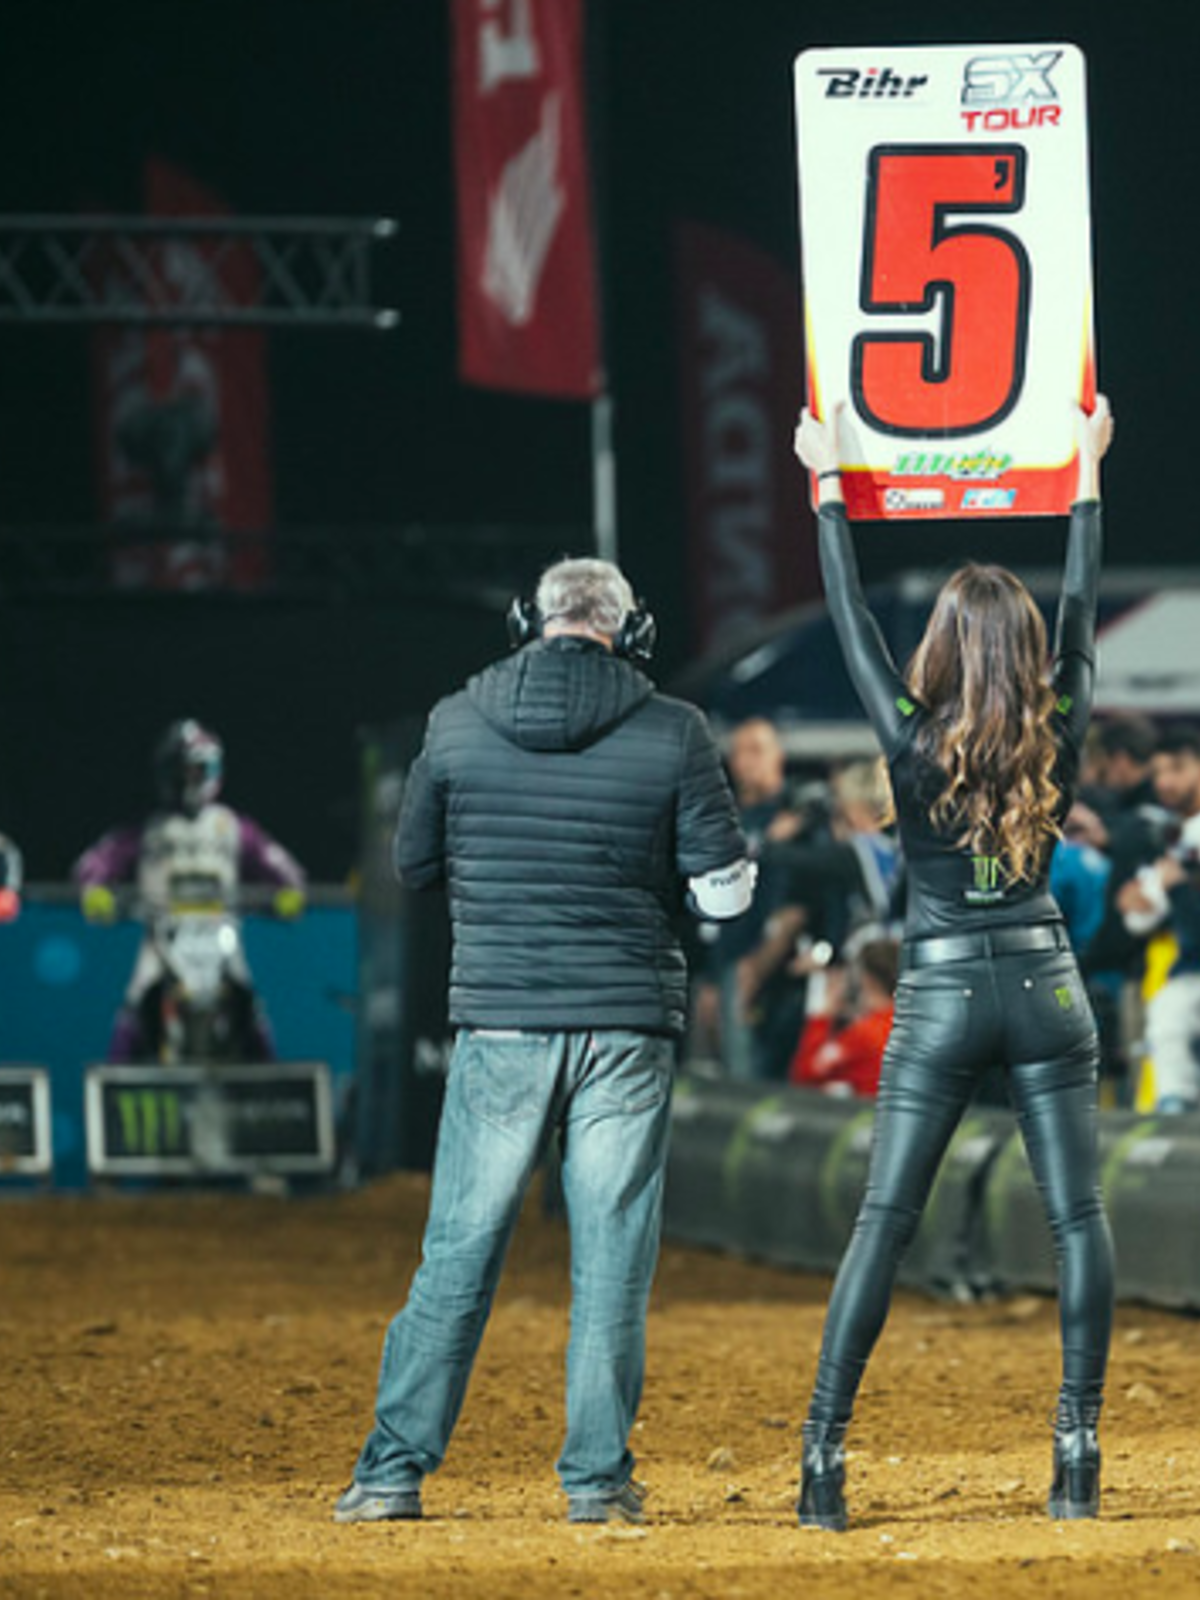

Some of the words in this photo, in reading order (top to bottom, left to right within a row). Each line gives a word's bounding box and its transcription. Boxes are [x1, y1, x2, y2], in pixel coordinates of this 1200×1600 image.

[816, 67, 929, 99] Bihr
[960, 50, 1064, 105] SX
[960, 104, 1062, 133] TOUR
